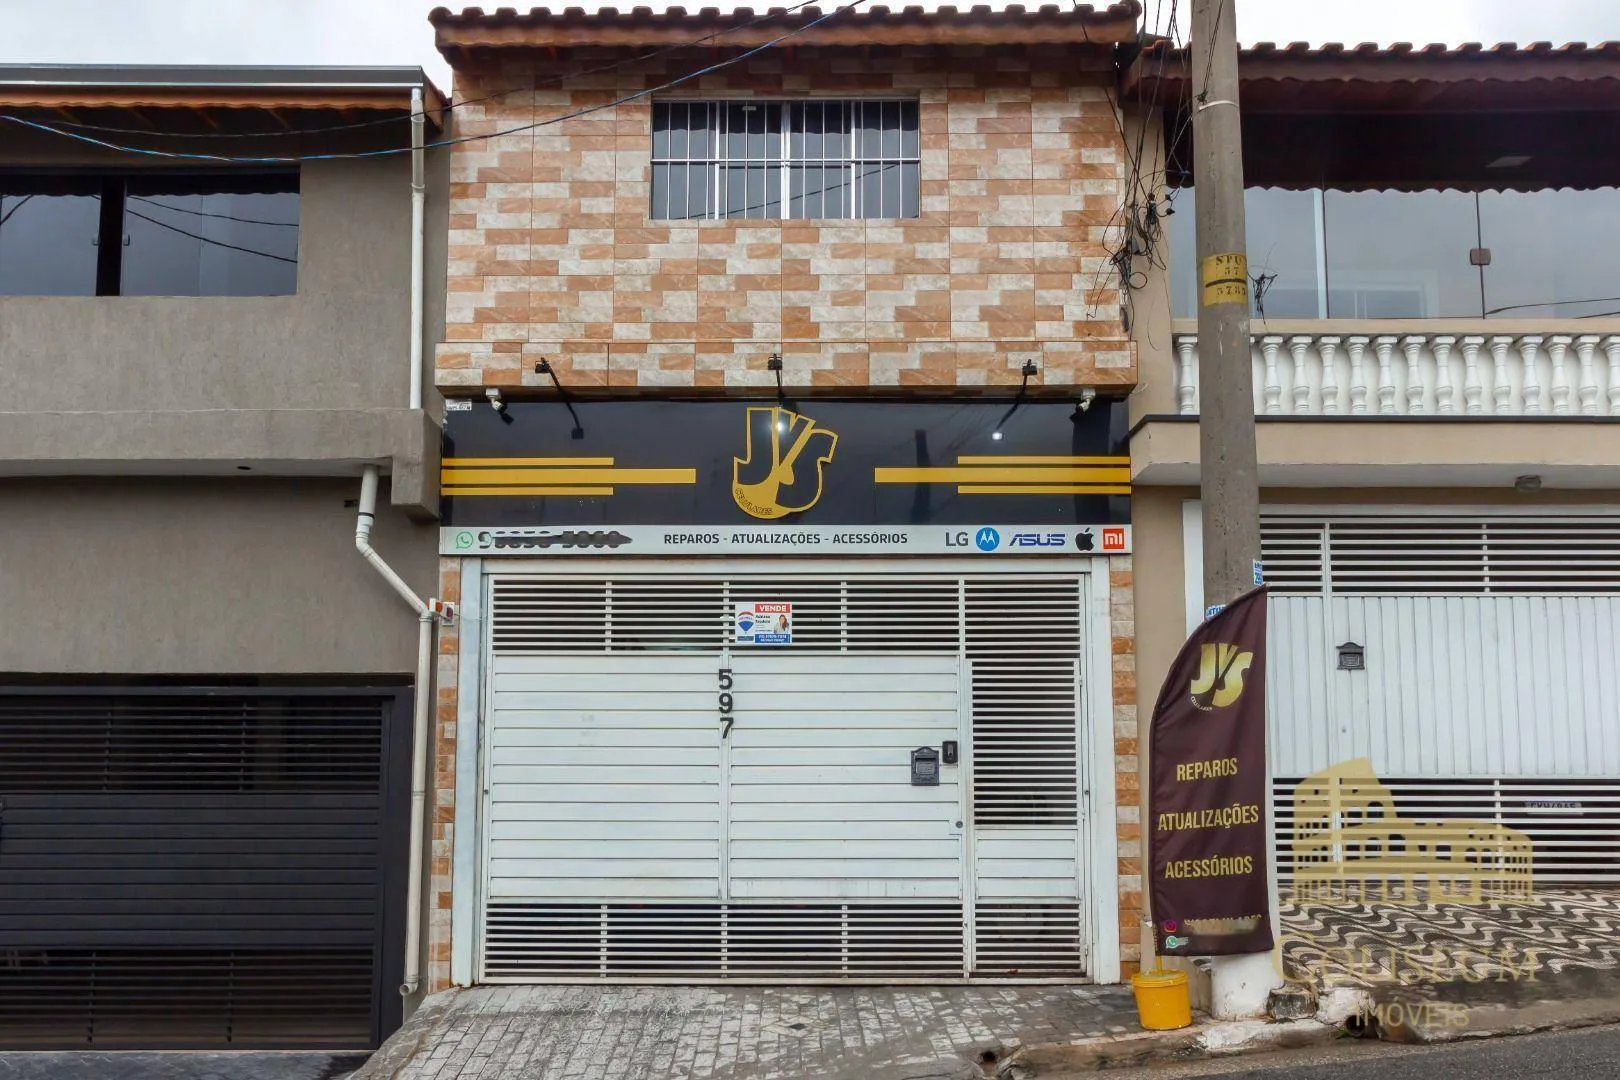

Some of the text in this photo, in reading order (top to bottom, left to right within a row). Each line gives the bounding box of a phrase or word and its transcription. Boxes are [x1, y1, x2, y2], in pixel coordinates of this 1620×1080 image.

[664, 533, 720, 544] REPAROS
[731, 531, 821, 546] ATUALIZAÇÕES
[832, 531, 908, 544] ACESSÓRIOS
[945, 532, 968, 547] LG
[1009, 533, 1066, 547] ASUS
[759, 604, 787, 612] VENDE
[718, 669, 734, 739] 597
[1176, 757, 1238, 782] REPAROS
[1158, 803, 1259, 831] ATUALIZAÇÕES
[1165, 854, 1253, 879] ACESSÓRIOS
